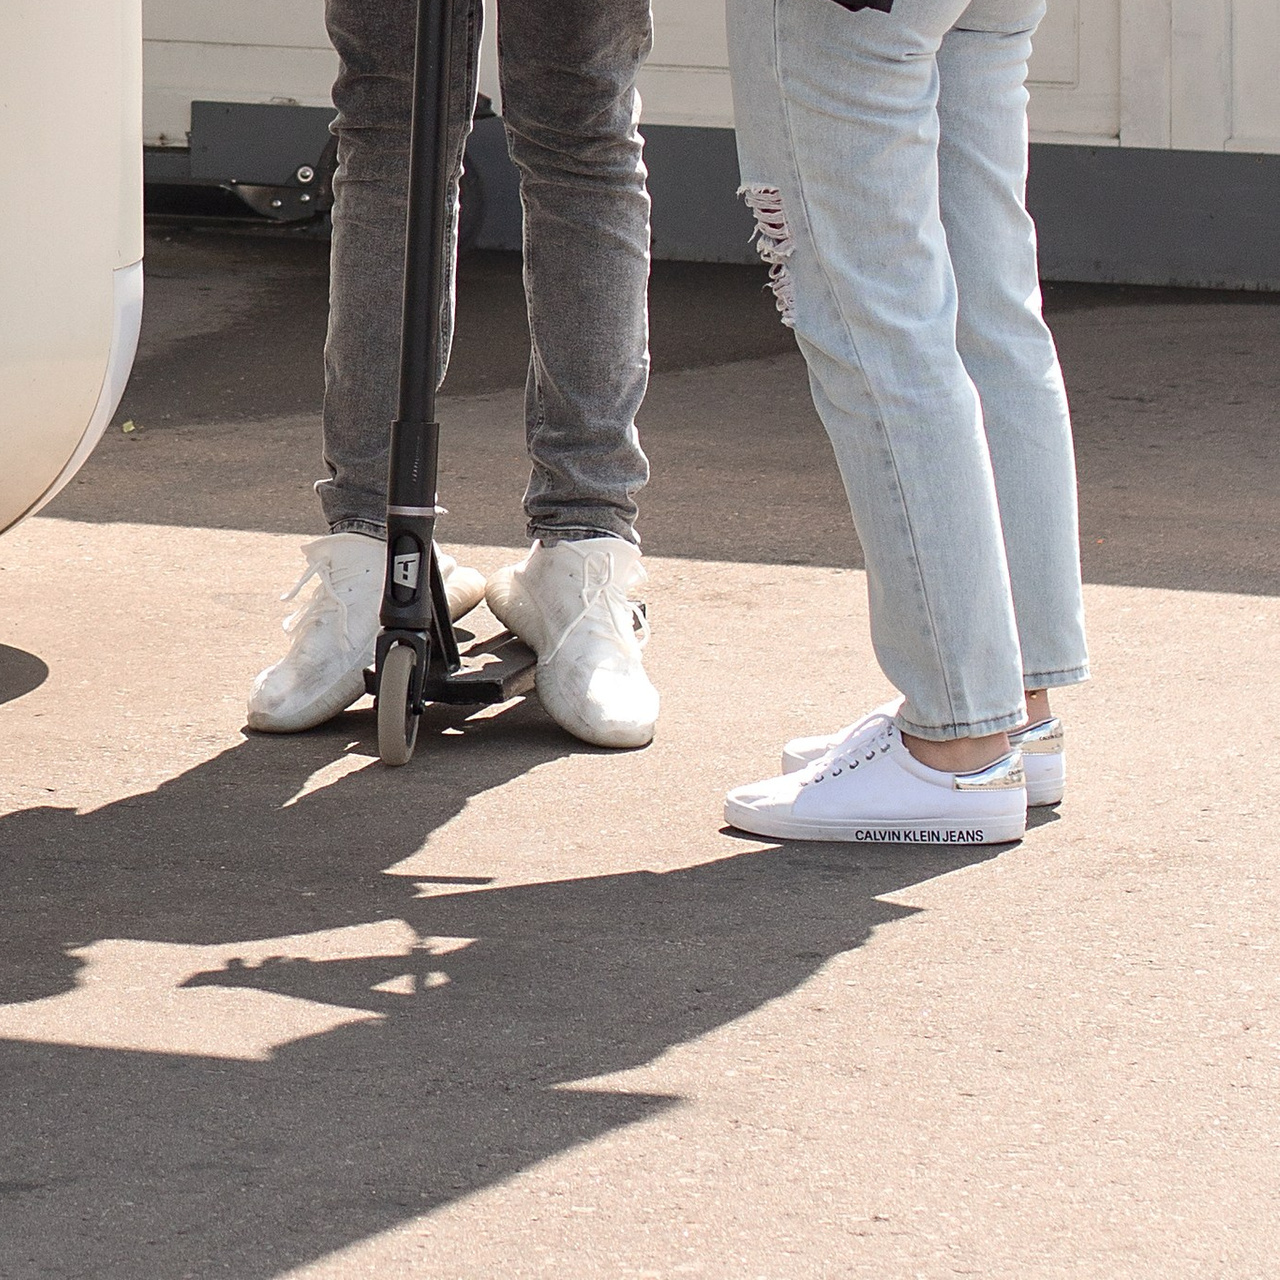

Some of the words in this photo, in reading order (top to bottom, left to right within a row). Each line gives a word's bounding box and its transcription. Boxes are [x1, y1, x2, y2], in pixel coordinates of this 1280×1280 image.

[855, 829, 901, 841] CALVIN
[903, 829, 942, 842] KLEIN
[942, 829, 984, 842] JEANS
